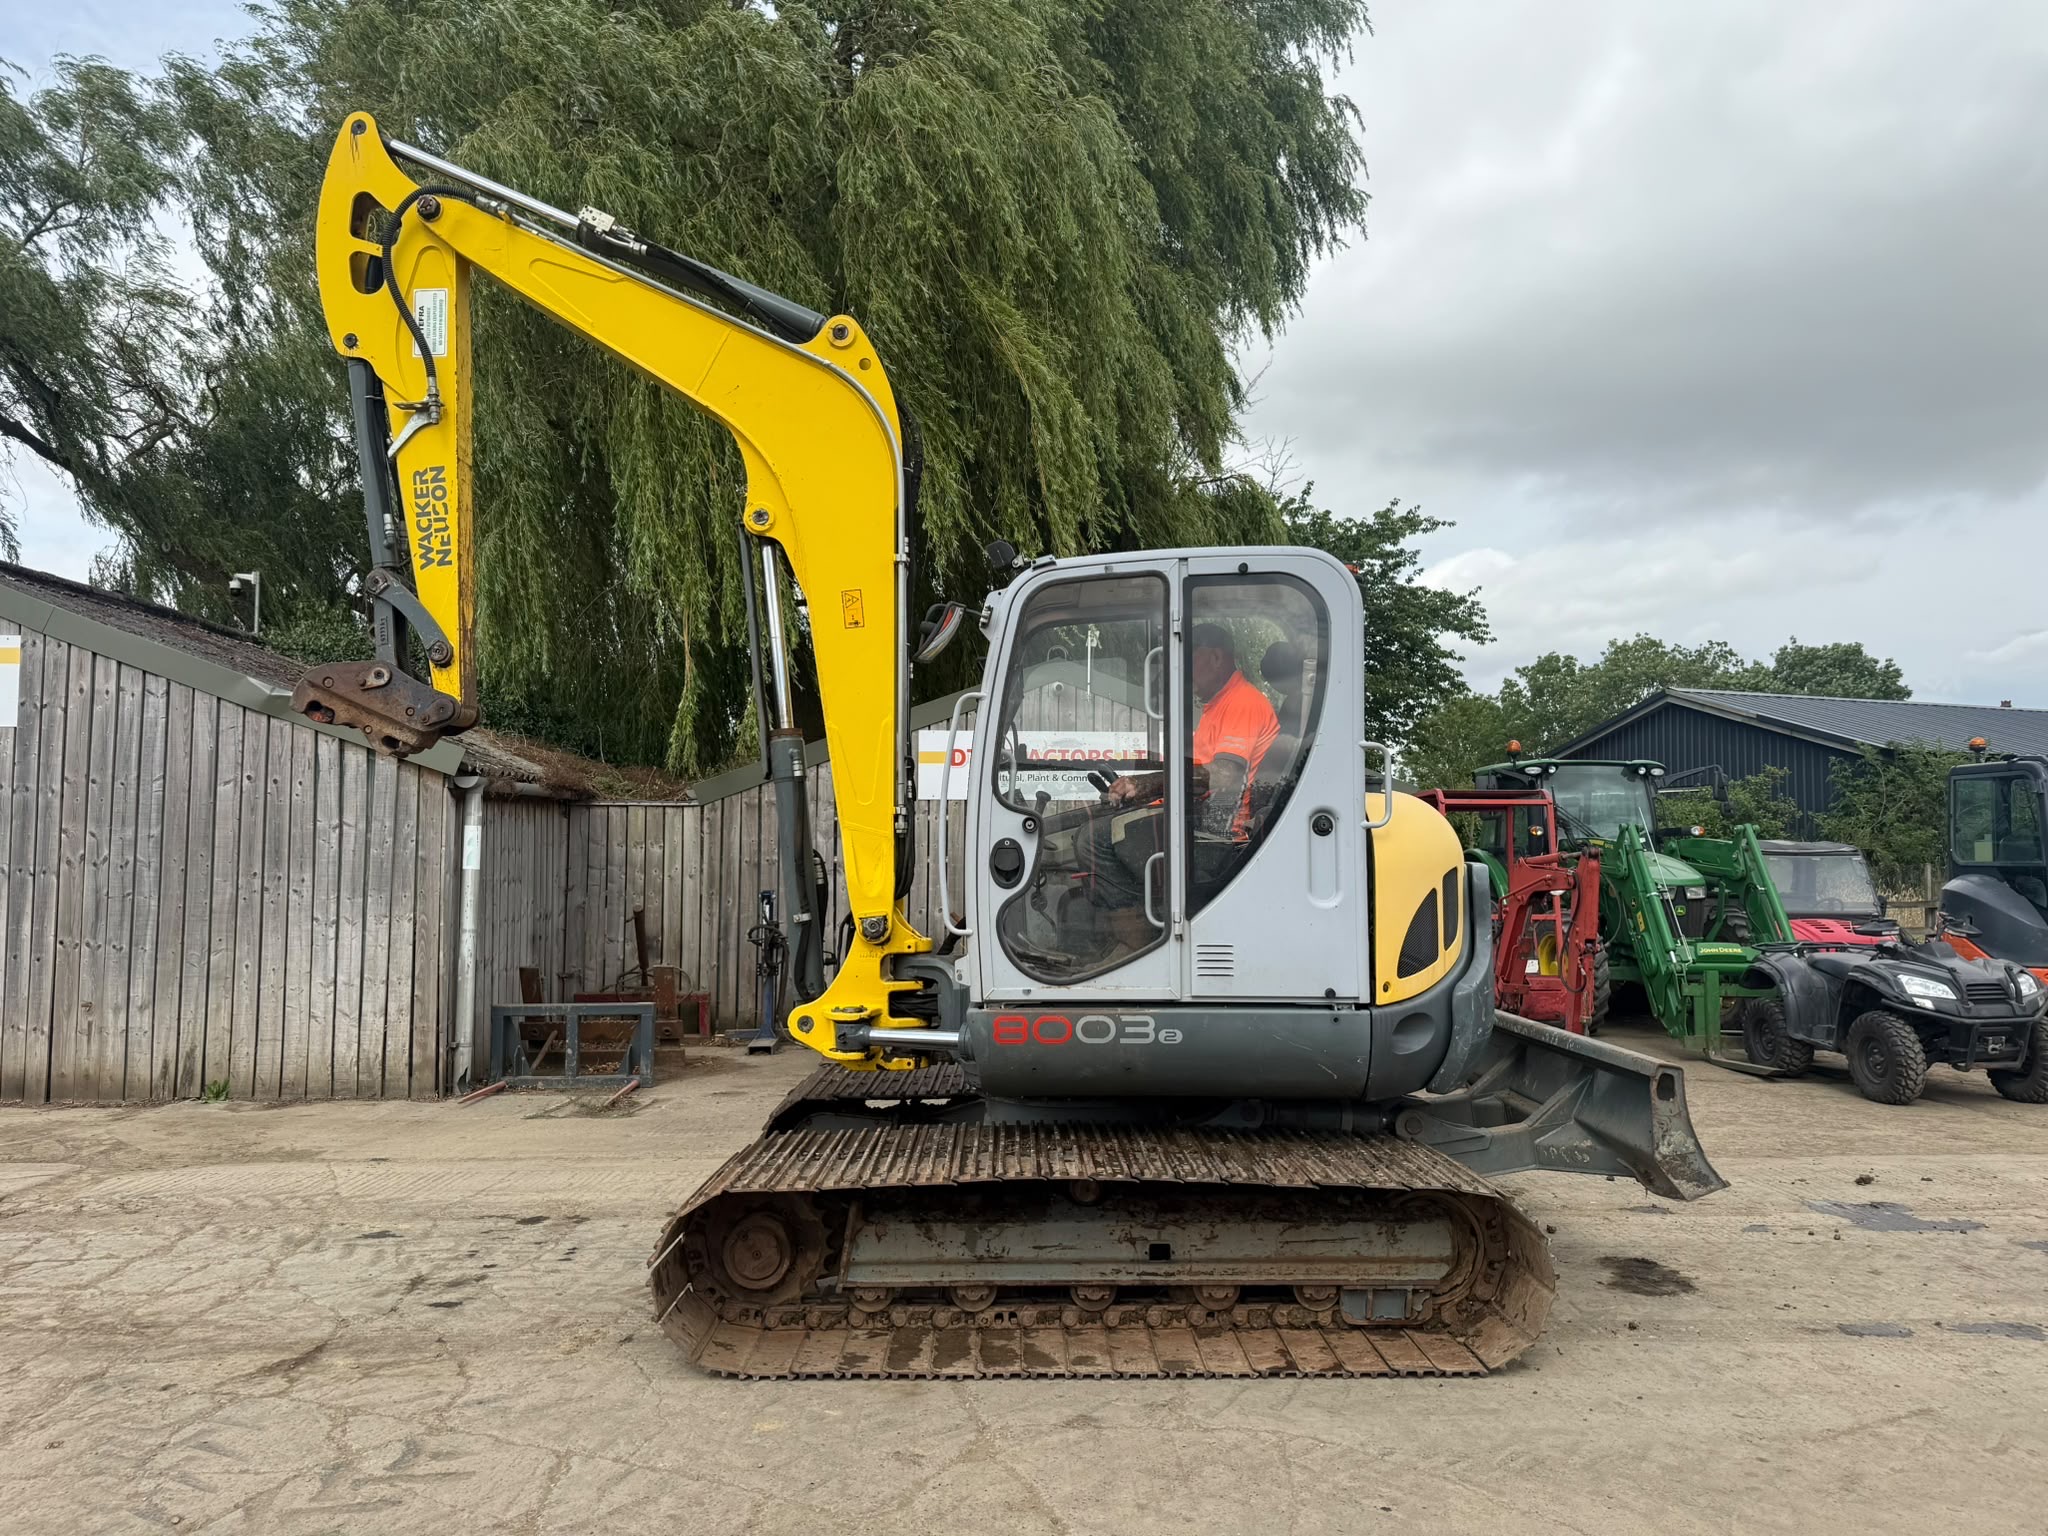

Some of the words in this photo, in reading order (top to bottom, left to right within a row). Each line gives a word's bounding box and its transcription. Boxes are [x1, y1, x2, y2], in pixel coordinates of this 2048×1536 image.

[412, 468, 434, 570] WACKER
[428, 466, 452, 566] NEUSON
[1027, 773, 1050, 782] Plant
[1052, 774, 1059, 782] &
